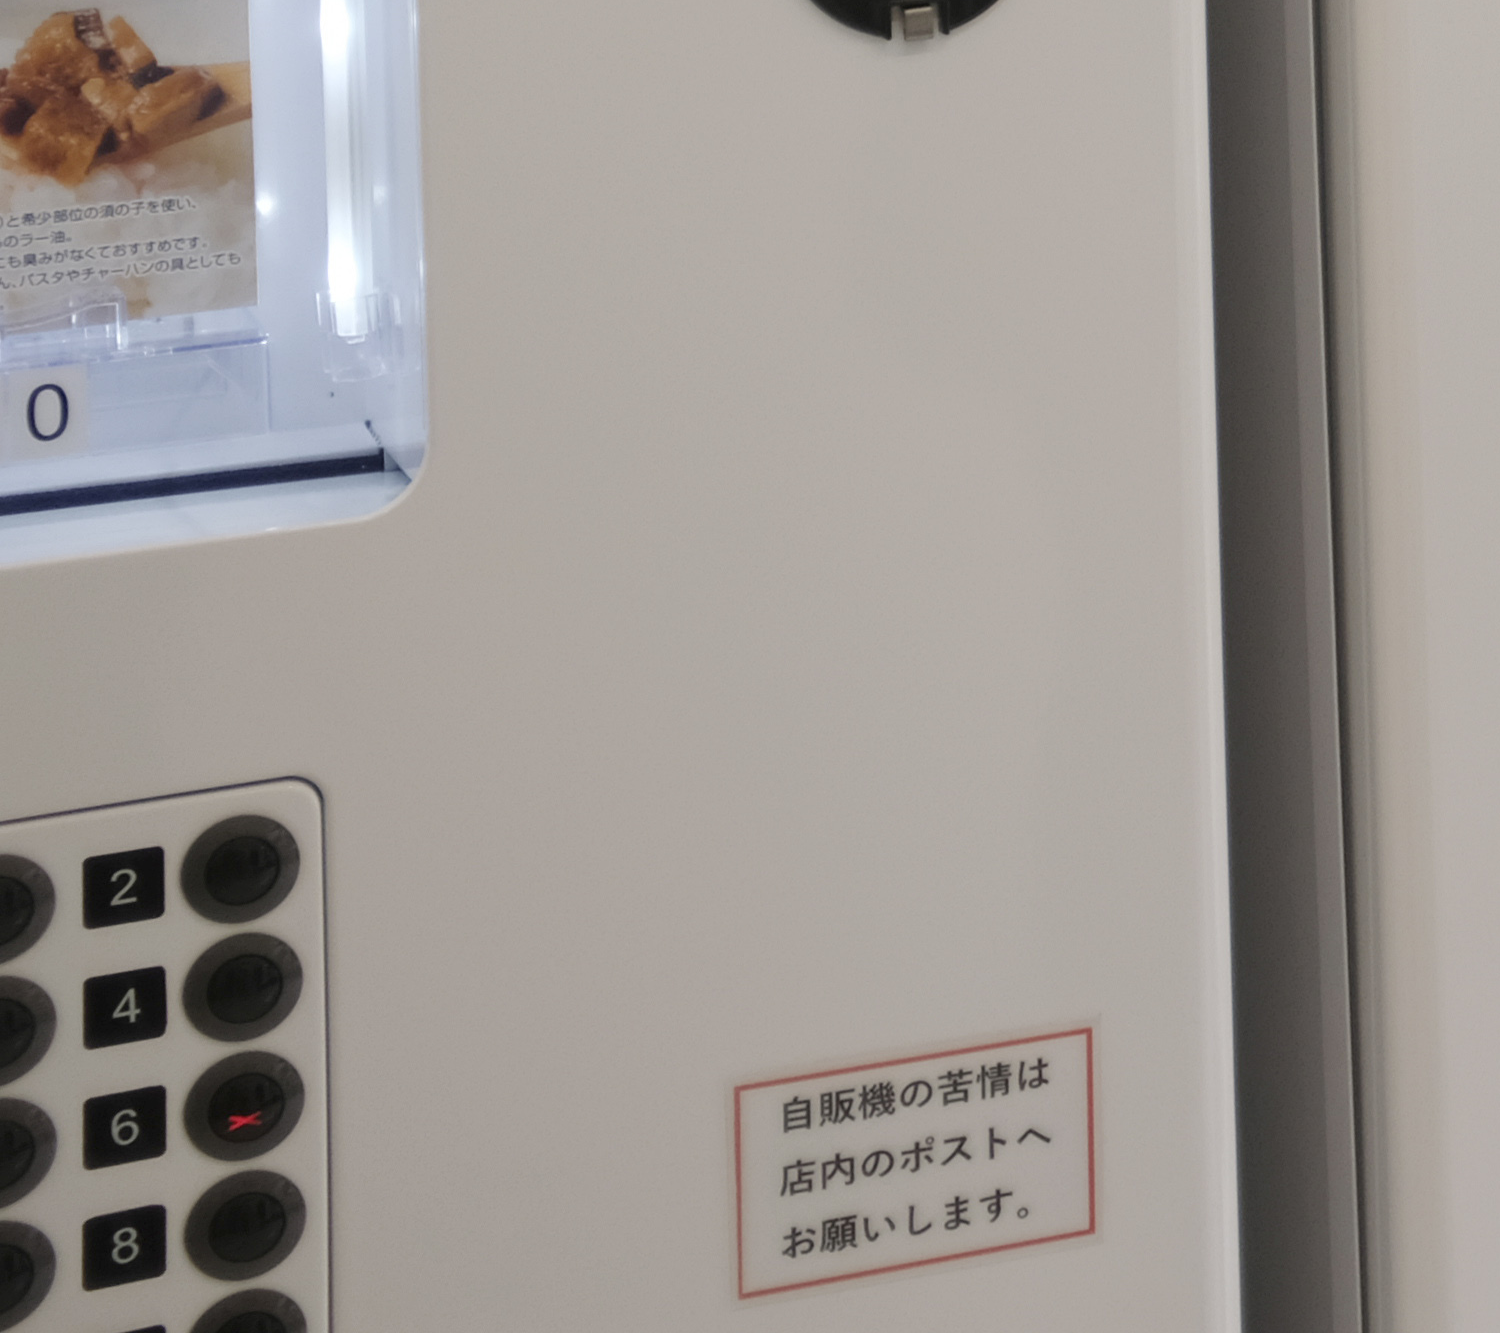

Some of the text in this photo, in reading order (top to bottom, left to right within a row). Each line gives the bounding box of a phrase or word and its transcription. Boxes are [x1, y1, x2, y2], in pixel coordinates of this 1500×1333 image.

[110, 868, 138, 907] 2
[112, 987, 141, 1024] 4
[782, 1057, 1050, 1134] 自販機の苦情は
[110, 1109, 140, 1146] 6
[780, 1127, 1052, 1197] 店内のポストへ
[781, 1188, 1030, 1259] お願いします。
[110, 1226, 140, 1265] 8
